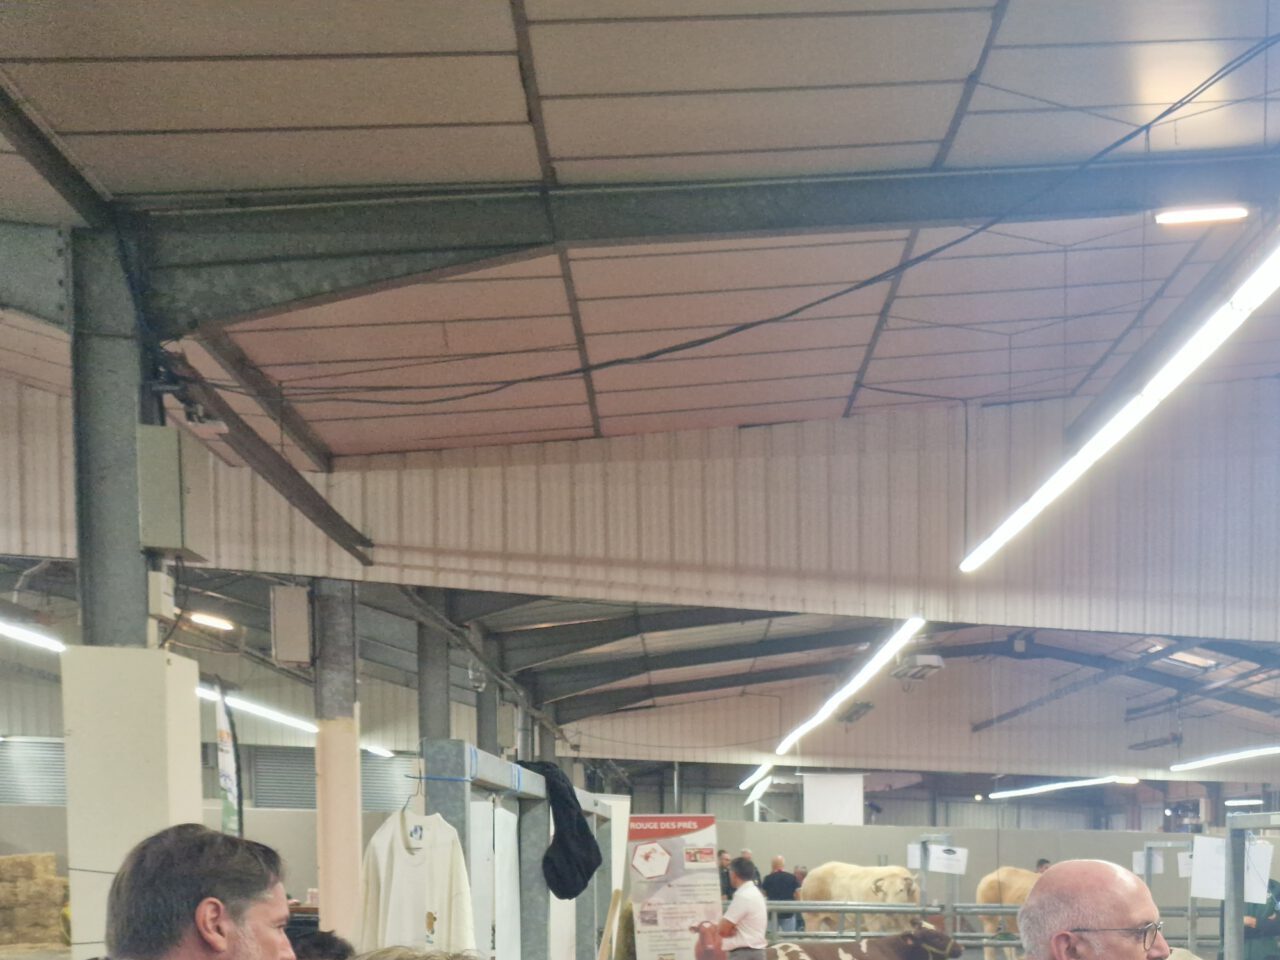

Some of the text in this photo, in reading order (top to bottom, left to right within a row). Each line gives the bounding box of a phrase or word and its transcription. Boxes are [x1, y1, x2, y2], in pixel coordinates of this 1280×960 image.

[629, 820, 699, 830] ROUGE DES PRÉS
